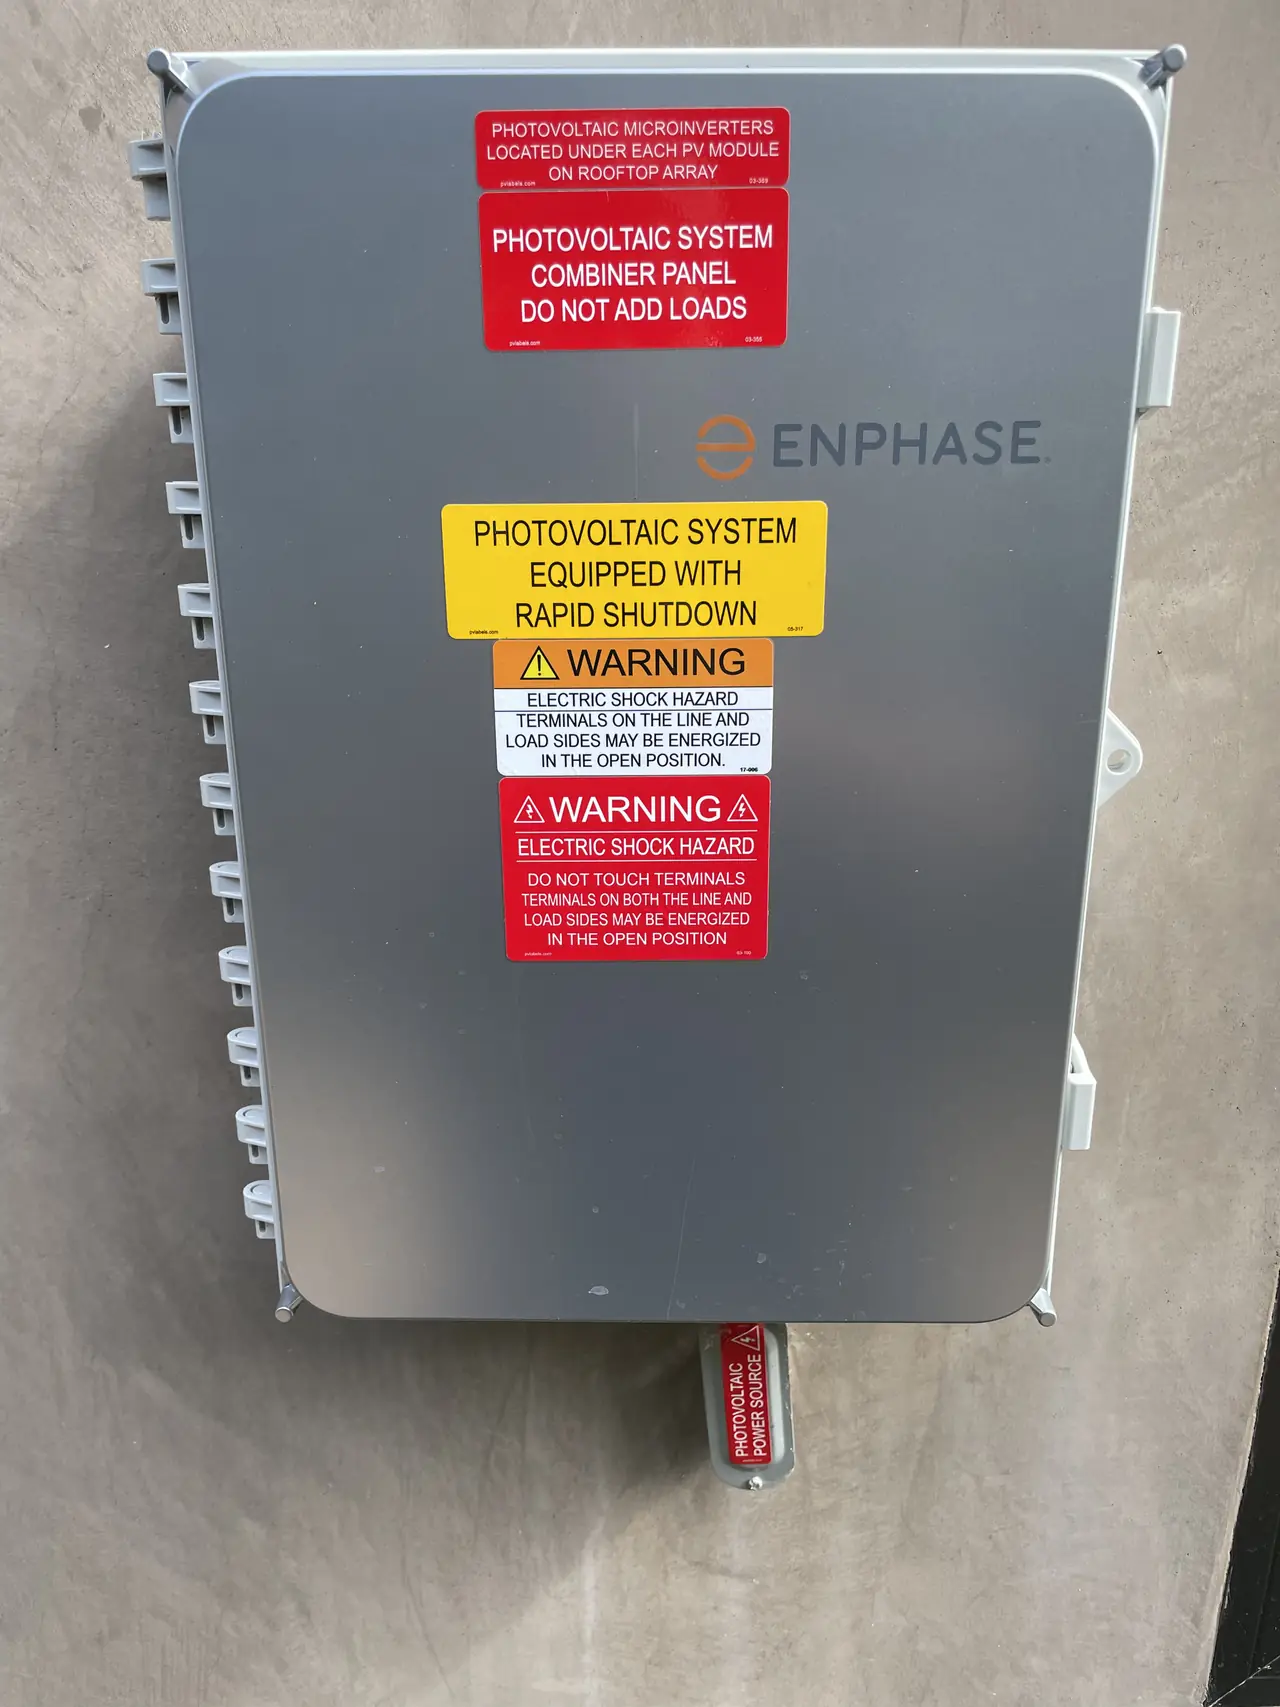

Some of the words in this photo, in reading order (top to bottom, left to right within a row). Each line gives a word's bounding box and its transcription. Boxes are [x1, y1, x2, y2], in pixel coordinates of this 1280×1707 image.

[492, 121, 619, 138] PHOTOVOLTAIC
[624, 120, 774, 136] MICROINVERTERS
[487, 144, 563, 160] LOCATED
[568, 144, 626, 159] UNDER
[632, 143, 677, 158] EACH
[682, 143, 703, 157] PV
[709, 142, 779, 157] MODULE
[549, 167, 573, 181] ON
[578, 166, 659, 181] ROOFTOP
[663, 165, 718, 179] ARRAY
[493, 226, 671, 252] PHOTOVOLTAIC
[678, 225, 773, 249] SYSTEM
[531, 262, 656, 287] COMBINER
[663, 261, 736, 285] PANEL
[521, 299, 554, 322] DO
[562, 299, 610, 321] NOT
[614, 297, 662, 321] ADD
[670, 296, 747, 319] LOADS
[773, 420, 1042, 467] ENPHASE
[475, 519, 679, 547] PHOTOVOLTAIC
[688, 518, 796, 544] SYSTEM
[530, 561, 666, 588] EQUIPPED
[675, 560, 741, 586] WITH
[516, 602, 595, 628] RAPID
[603, 601, 757, 627] SHUTDOWN
[567, 648, 746, 676] WARNING
[527, 692, 606, 707] ELECTRIC
[611, 692, 668, 707] SHOCK
[672, 692, 738, 707] HAZARD
[516, 713, 607, 728] TERMINALS
[612, 713, 635, 727] ON
[640, 713, 672, 727] THE
[676, 713, 711, 727] LINE
[716, 713, 749, 726] AND
[506, 734, 549, 749] LOAD
[553, 733, 600, 748] SIDES
[605, 733, 639, 748] MAY
[643, 733, 664, 748] BE
[669, 732, 761, 747] ENERGIZED
[541, 754, 556, 768] IN
[560, 754, 593, 768] THE
[597, 753, 642, 768] OPEN
[646, 753, 725, 767] POSITION.
[549, 796, 721, 823] WARNING
[517, 838, 606, 856] ELECTRIC
[611, 837, 674, 855] SHOCK
[679, 837, 755, 855] HAZARD
[528, 873, 551, 886] DO
[556, 873, 589, 886] NOT
[594, 873, 649, 886] TOUCH
[654, 872, 745, 886] TERMINALS
[522, 893, 596, 907] TERMINALS
[600, 893, 618, 906] ON
[623, 893, 659, 906] BOTH
[663, 893, 688, 905] THE
[692, 892, 721, 905] LINE
[725, 892, 752, 905] AND
[524, 913, 562, 926] LOAD
[566, 913, 608, 926] SIDES
[612, 913, 641, 926] MAY
[646, 913, 664, 925] BE
[669, 912, 750, 925] ENERGIZED
[548, 933, 563, 946] IN
[567, 933, 598, 945] THE
[603, 933, 647, 945] OPEN
[652, 932, 726, 945] POSITION
[748, 1354, 763, 1408] SOURCE
[729, 1362, 748, 1457] PHOTOVOLTAIC
[750, 1411, 767, 1457] POWER
